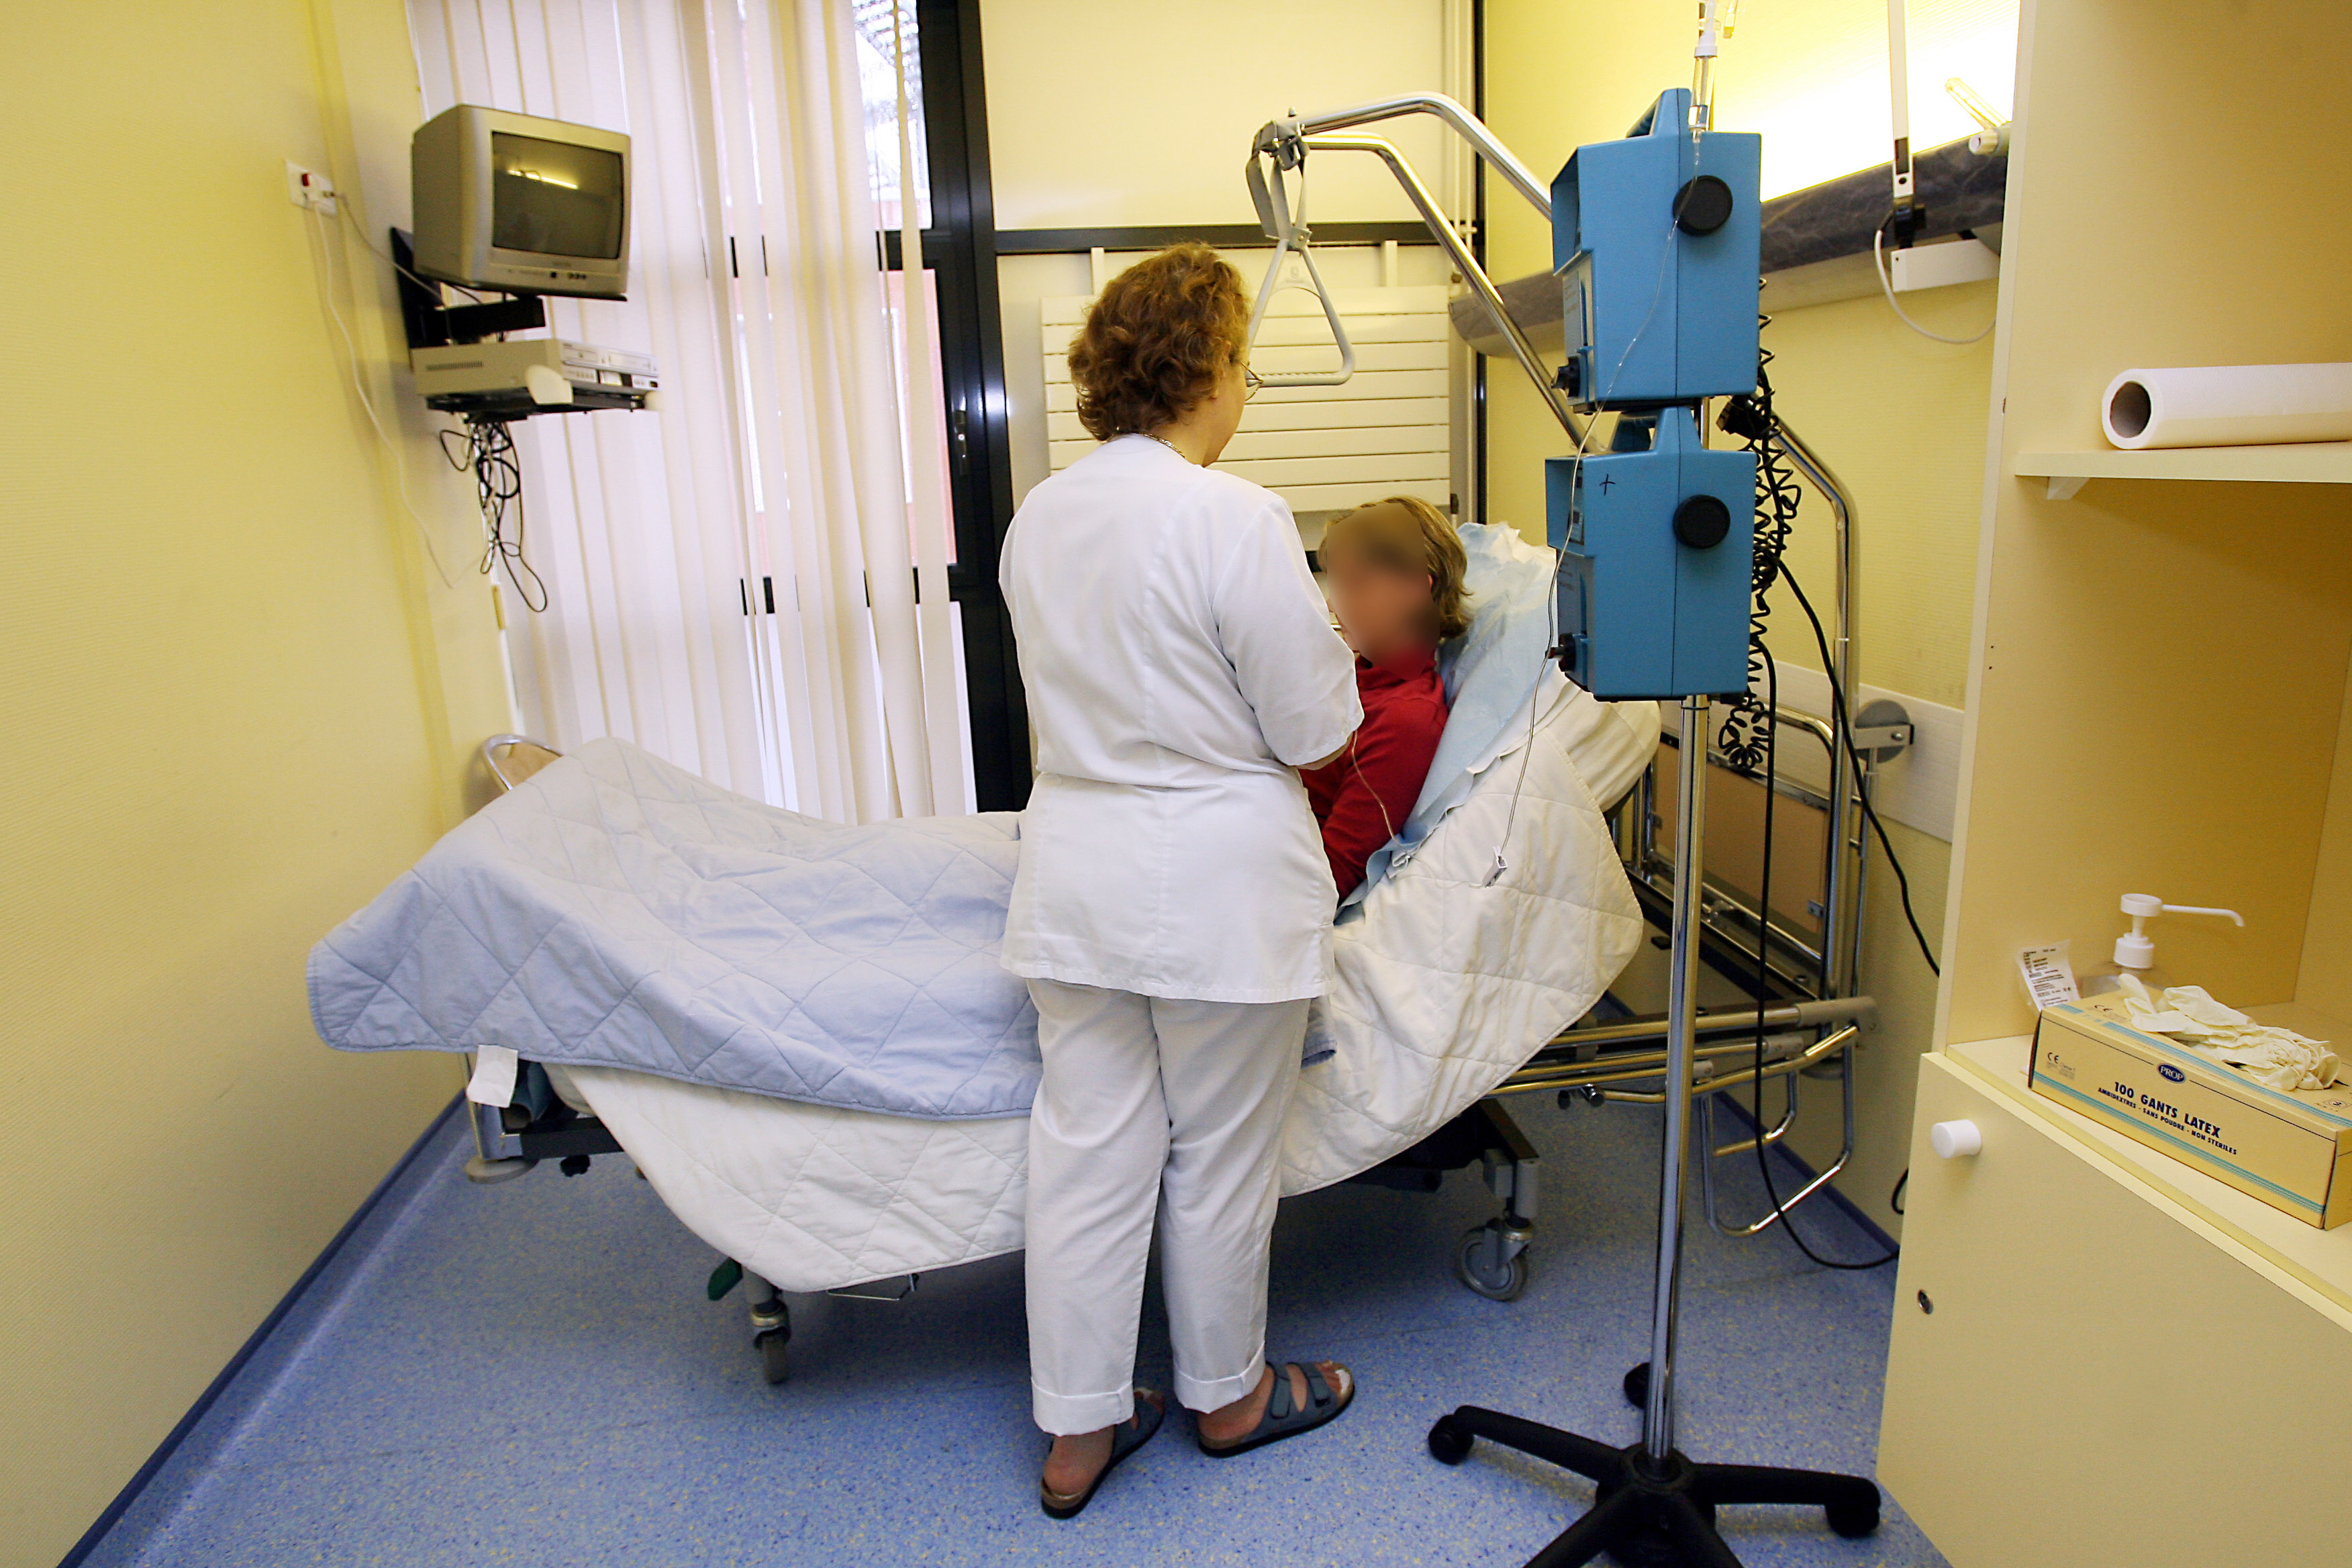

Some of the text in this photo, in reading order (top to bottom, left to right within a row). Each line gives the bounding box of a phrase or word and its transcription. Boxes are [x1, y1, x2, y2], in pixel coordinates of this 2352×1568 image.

[2047, 1052, 2059, 1065] CE
[2160, 1065, 2184, 1080] PROP
[2115, 1081, 2221, 1138] 100 GANTS LATEX
[2143, 1108, 2159, 1119] SANS
[2160, 1116, 2185, 1131] POUDRE
[2191, 1130, 2206, 1141] NON
[2208, 1137, 2237, 1155] STERILES
